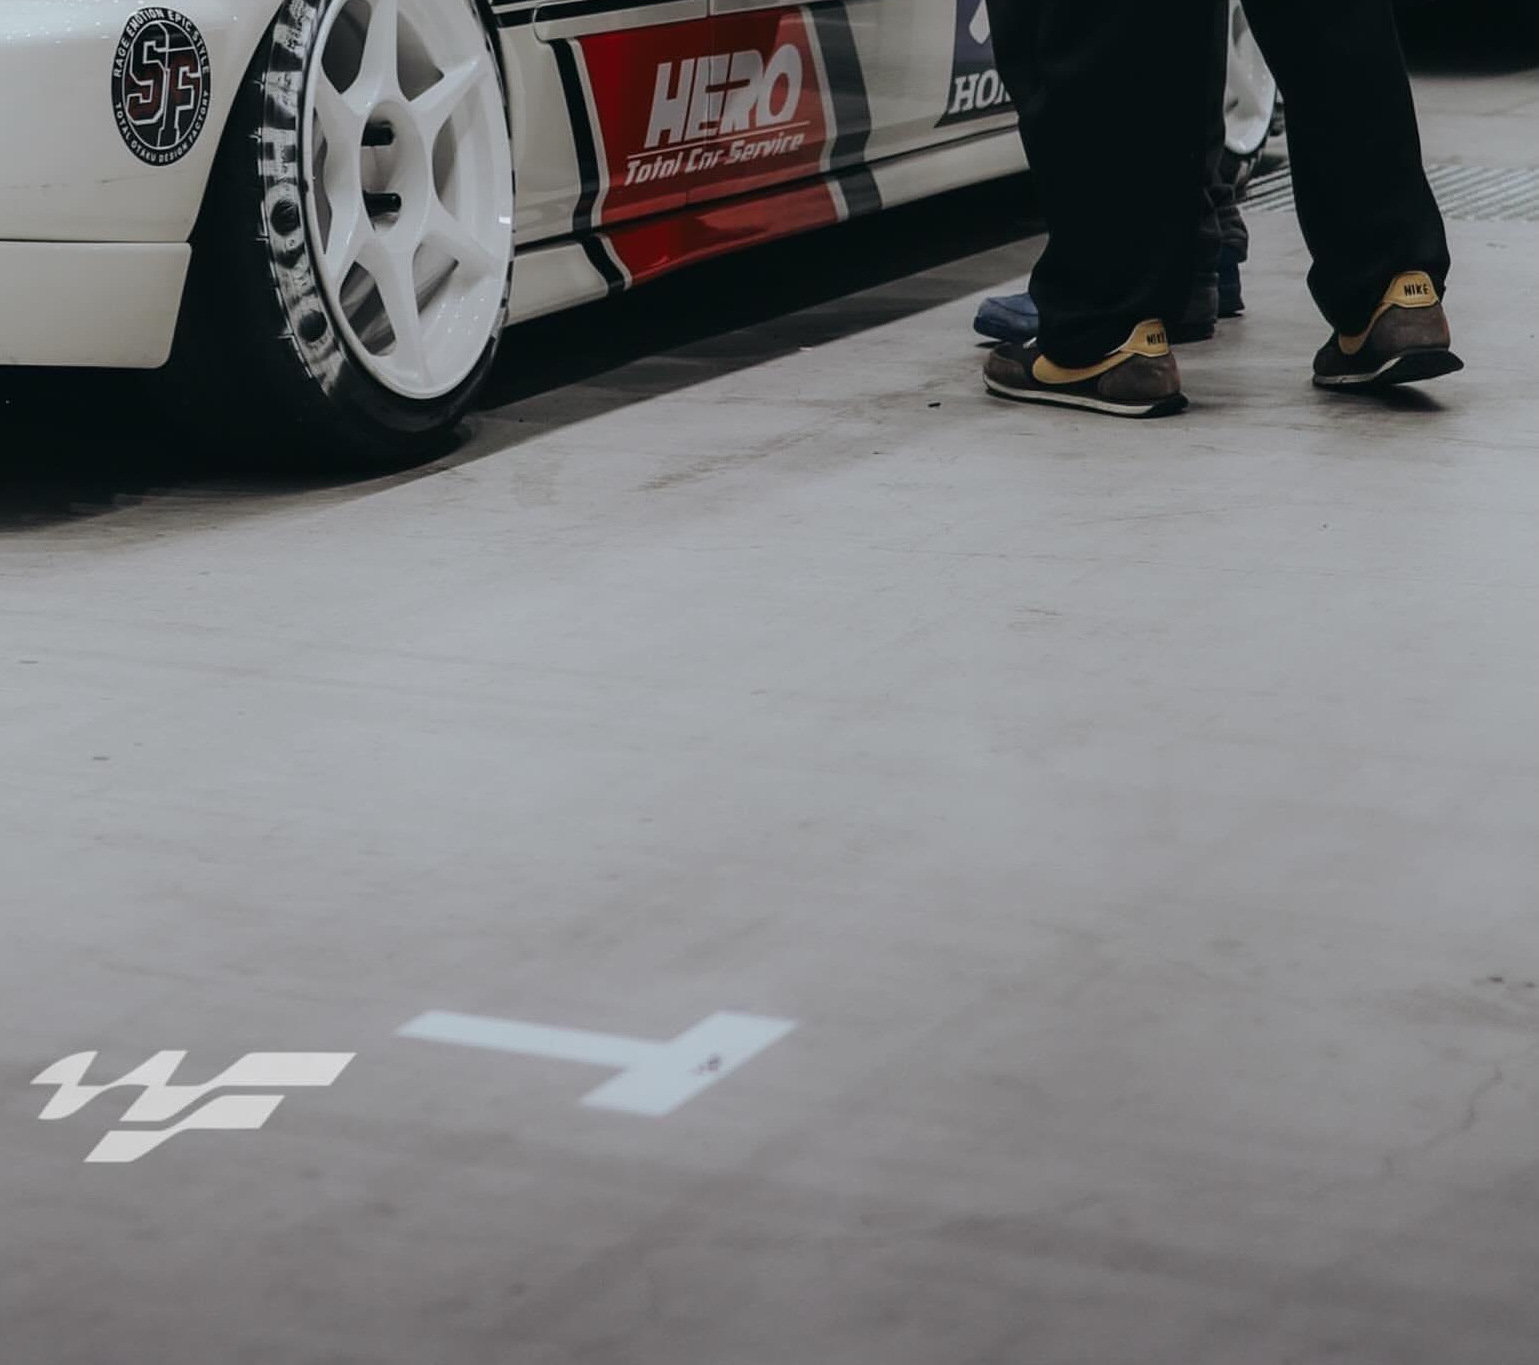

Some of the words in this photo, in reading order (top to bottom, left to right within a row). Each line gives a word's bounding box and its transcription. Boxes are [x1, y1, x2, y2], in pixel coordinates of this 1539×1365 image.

[167, 9, 192, 31] EPIC
[192, 31, 211, 73] STYLE
[643, 43, 803, 149] HERO
[624, 151, 684, 187] Total
[684, 147, 724, 173] Car
[724, 132, 805, 166] Service
[1404, 284, 1430, 297] NIKE
